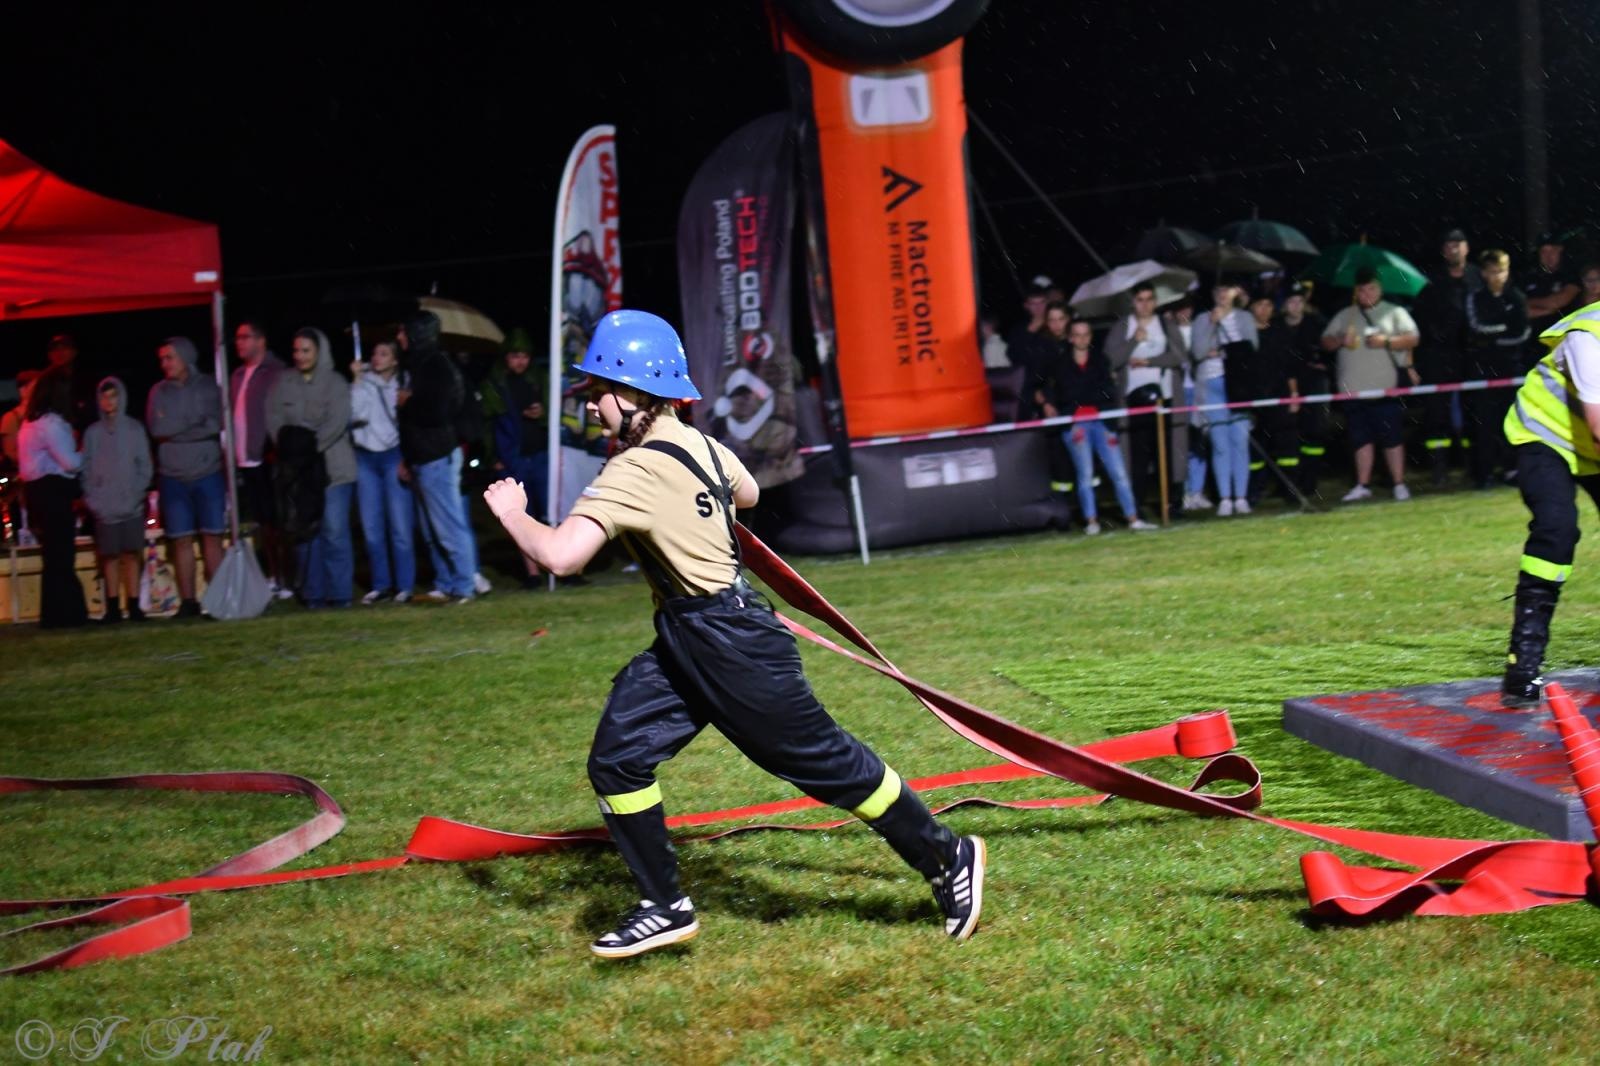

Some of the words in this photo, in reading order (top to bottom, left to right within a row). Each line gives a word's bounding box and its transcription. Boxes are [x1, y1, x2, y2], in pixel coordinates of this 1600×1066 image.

[713, 198, 733, 260] Poland
[889, 243, 904, 280] FIRE
[906, 220, 940, 361] Mactronic
